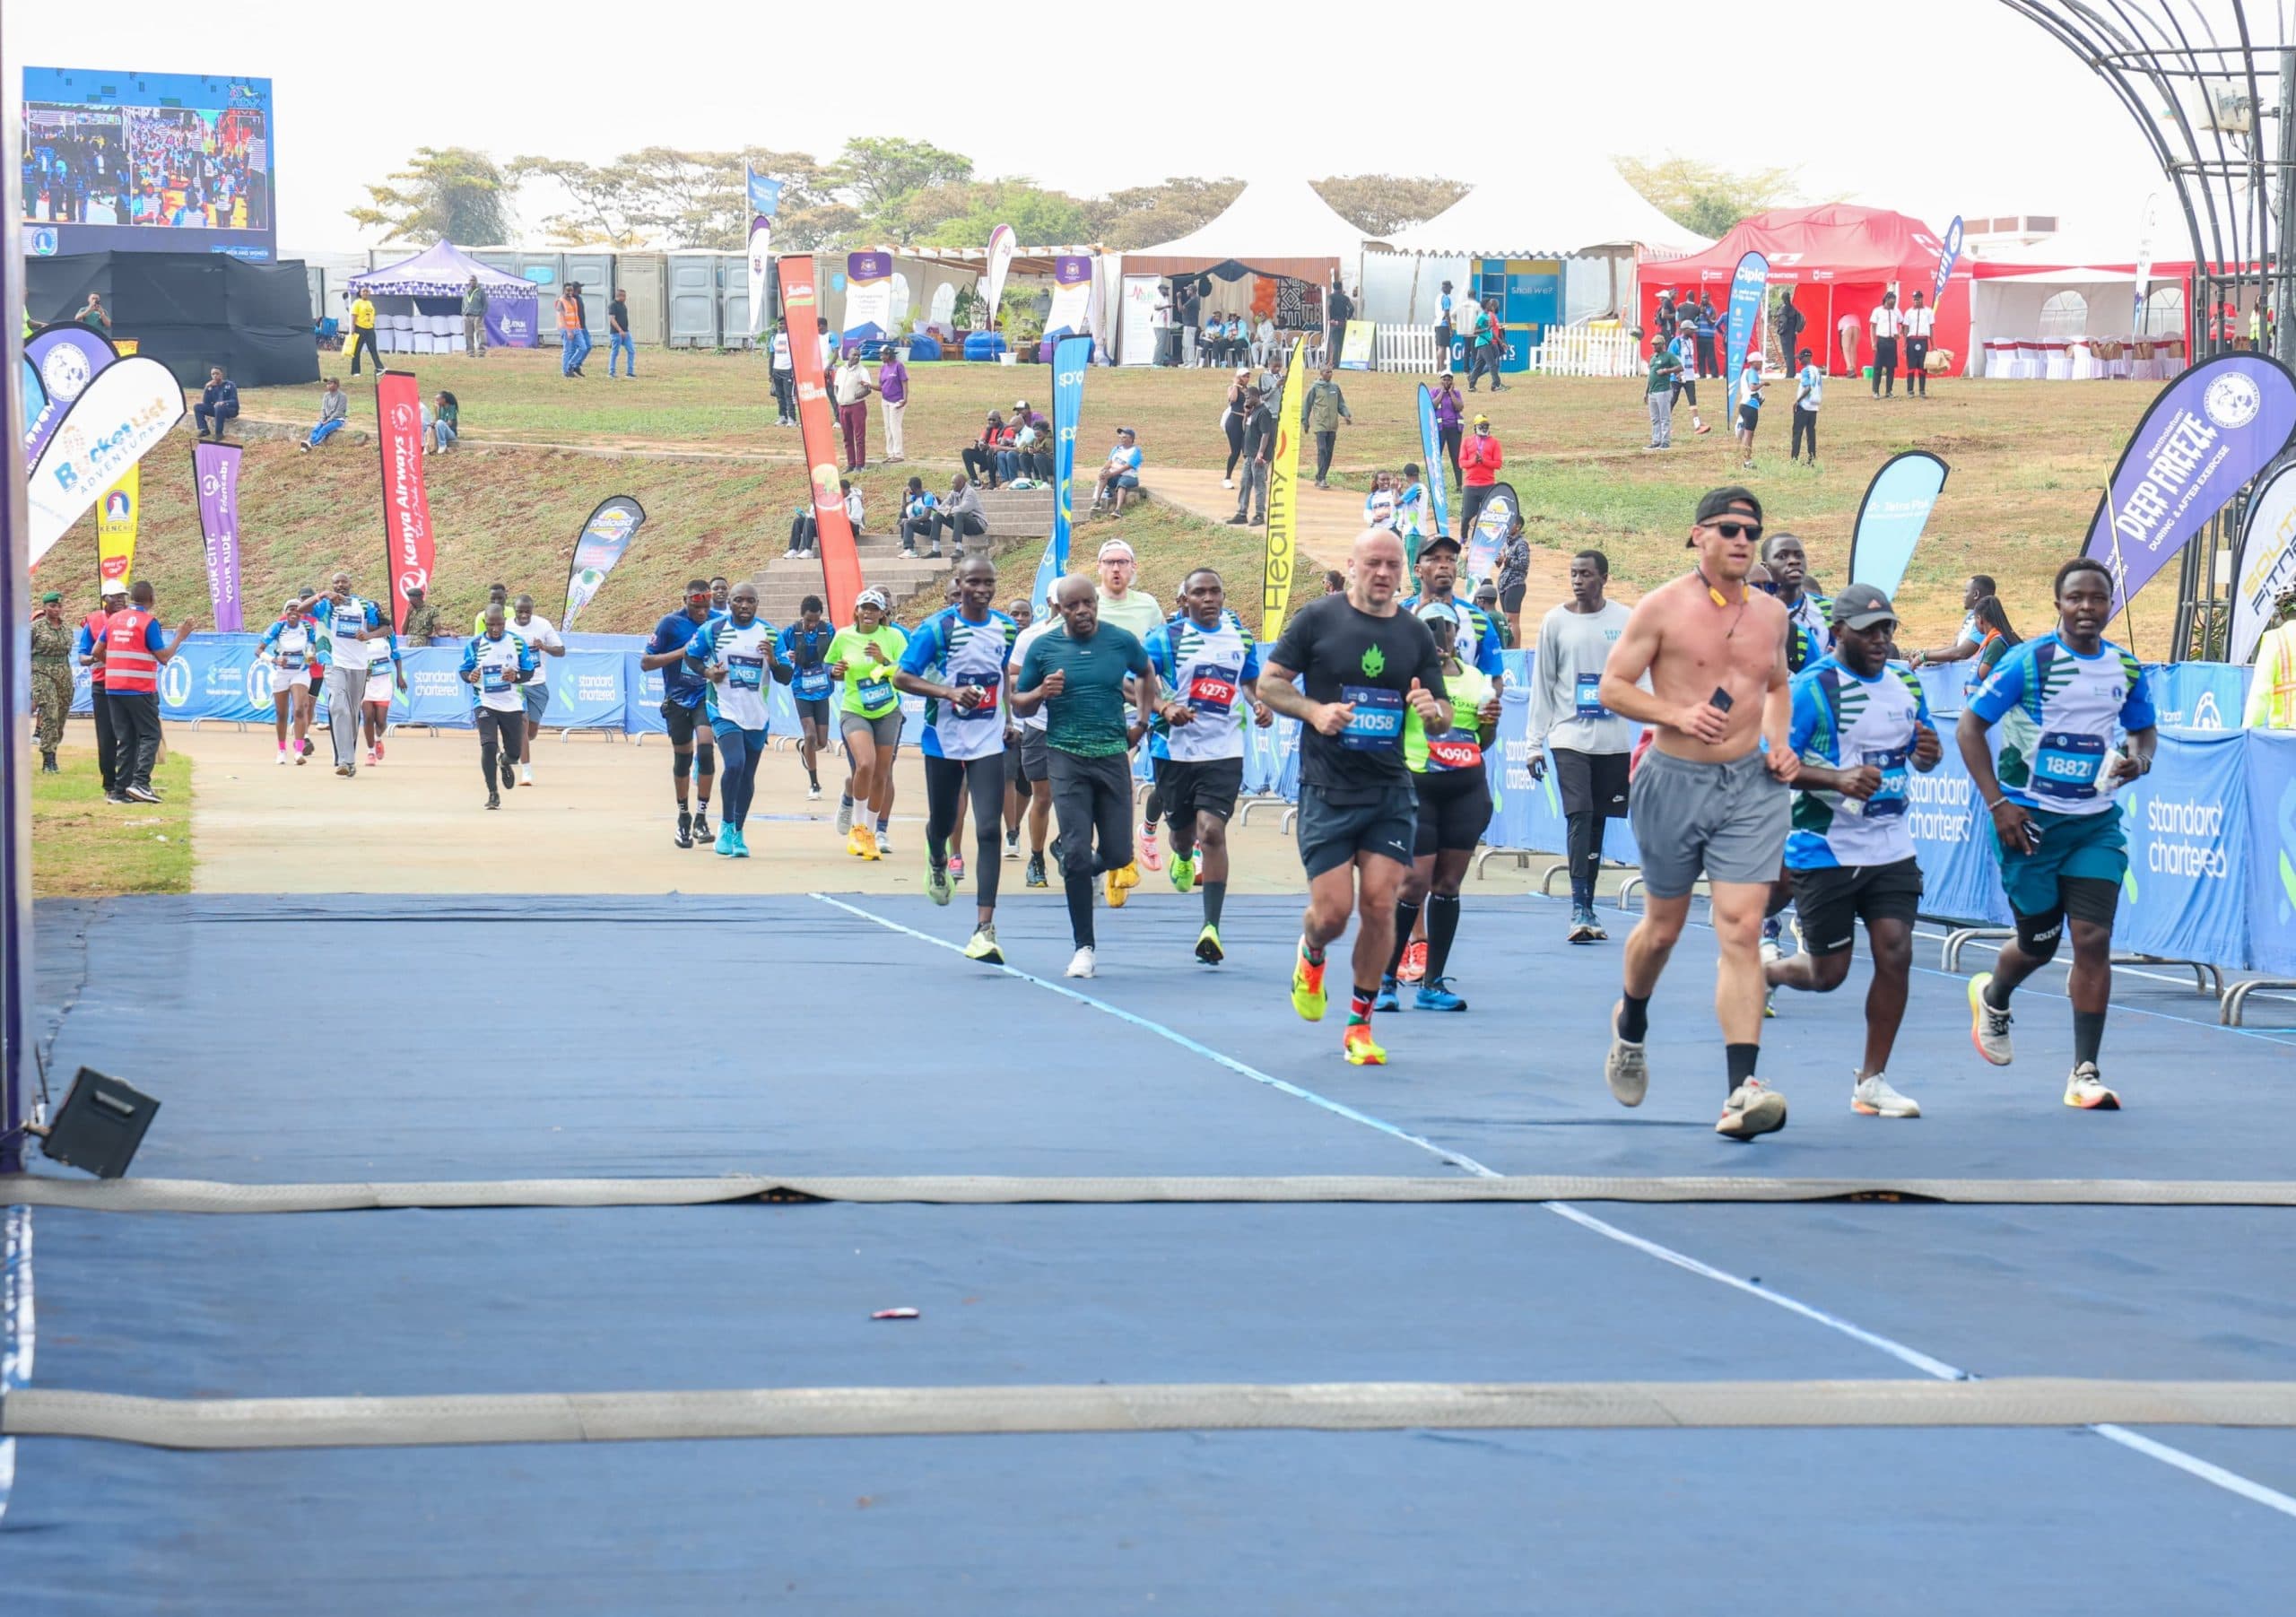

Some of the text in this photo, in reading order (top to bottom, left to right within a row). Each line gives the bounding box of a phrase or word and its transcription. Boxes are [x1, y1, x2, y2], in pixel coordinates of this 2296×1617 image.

[1736, 265, 1766, 283] Cipla
[1511, 286, 1553, 294] Shall We?
[395, 435, 409, 507] Airways
[2115, 481, 2170, 543] DEEP
[2150, 412, 2218, 495] FREEZE
[2148, 517, 2176, 552] DURING
[2179, 484, 2201, 512] AFTER
[2196, 444, 2231, 489] EXERCISE
[589, 517, 635, 528] Reload
[1479, 509, 1512, 523] Reload
[401, 511, 419, 567] Kenya
[1264, 468, 1290, 612] Healthy
[2243, 506, 2296, 599] SOUT
[223, 566, 234, 604] YOUR
[414, 670, 457, 683] standard
[414, 683, 459, 697] chartered
[578, 674, 614, 688] standard
[1198, 679, 1229, 700] 4275
[578, 687, 615, 701] chartered
[1348, 713, 1395, 731] 21058
[1436, 747, 1472, 762] 4090
[1909, 773, 1970, 807] standard
[1909, 807, 1972, 843] chartered
[2148, 795, 2224, 839] standard
[2148, 838, 2227, 879] chartered
